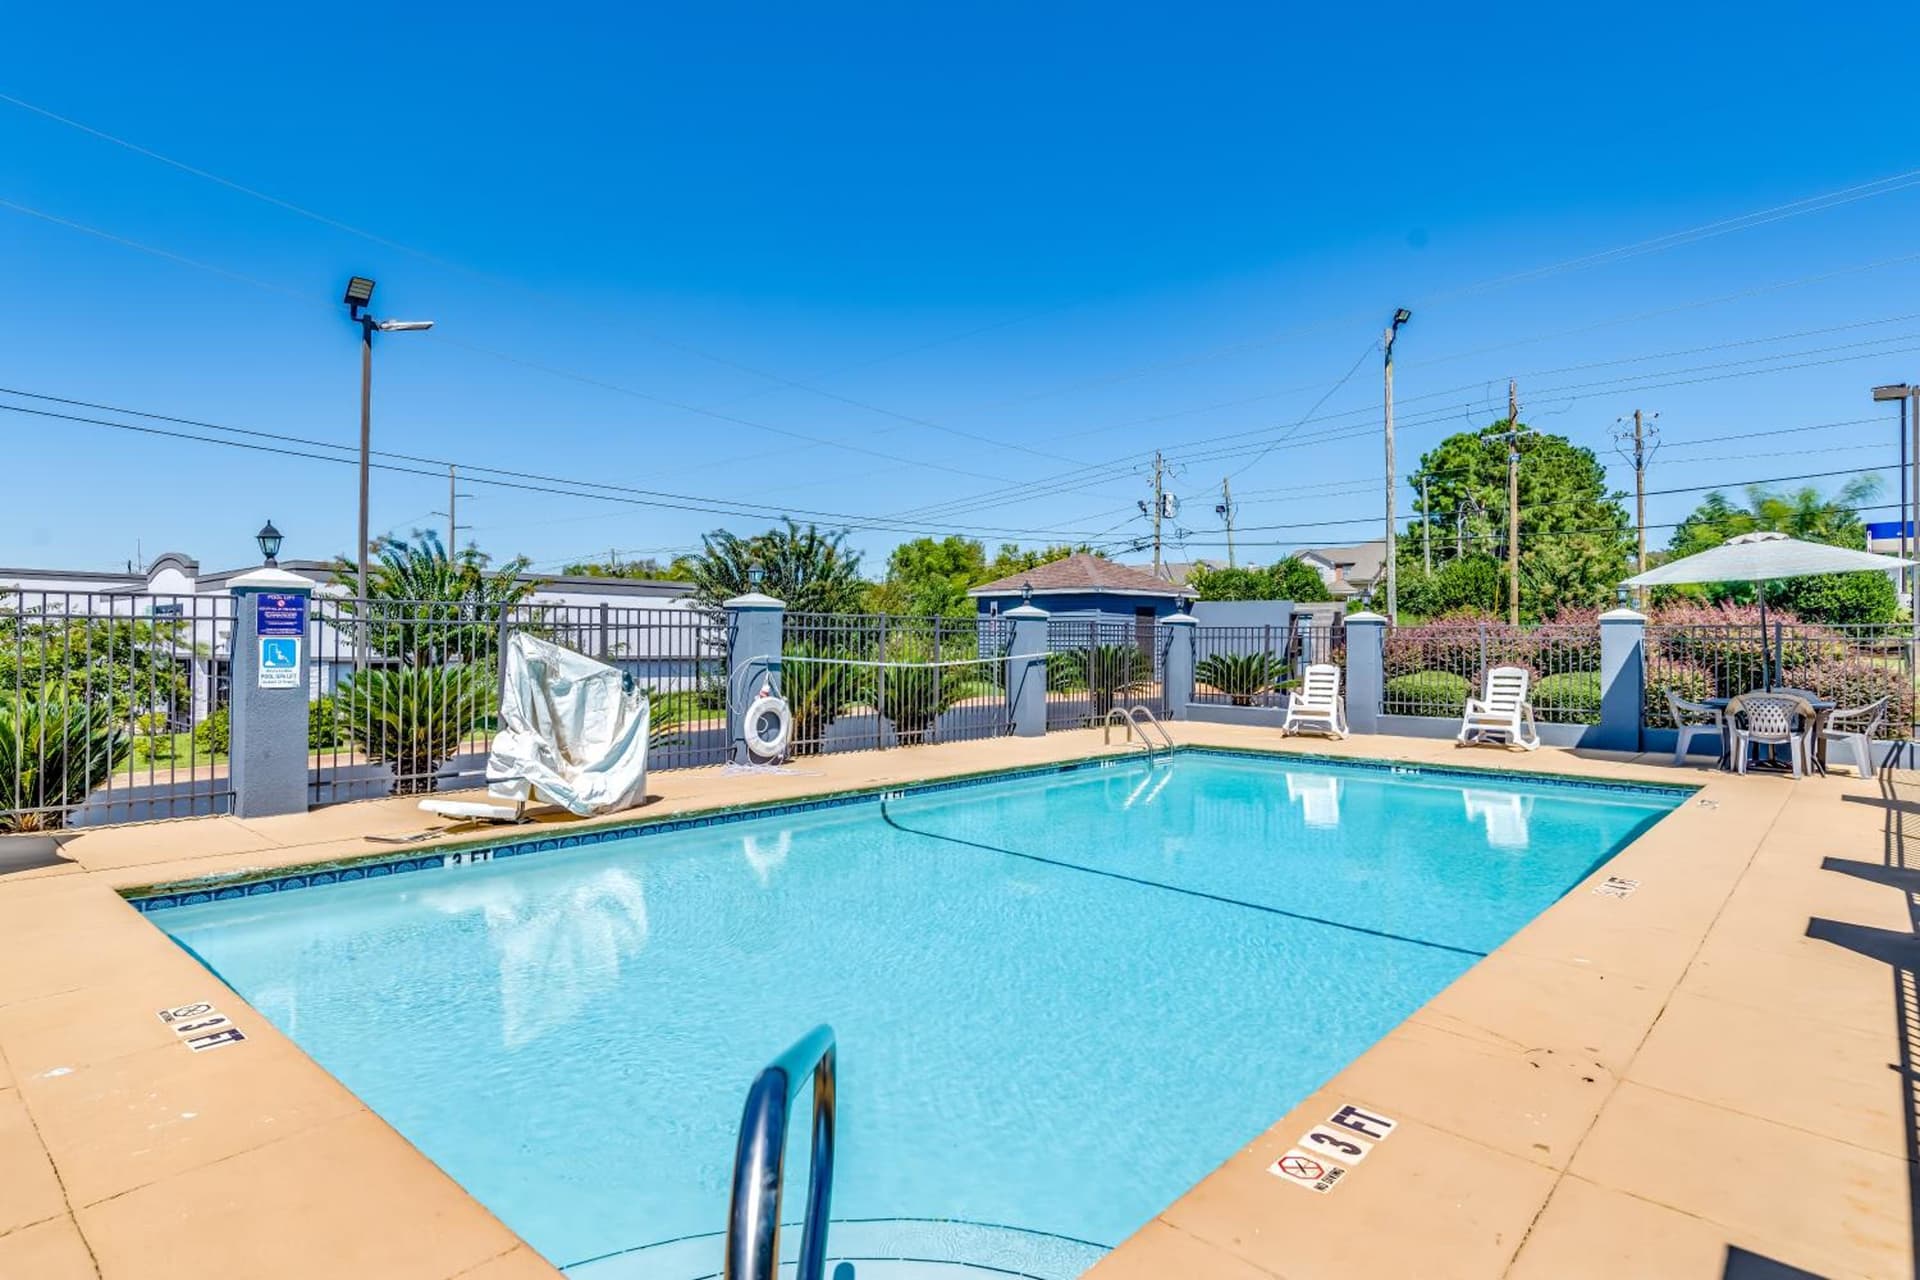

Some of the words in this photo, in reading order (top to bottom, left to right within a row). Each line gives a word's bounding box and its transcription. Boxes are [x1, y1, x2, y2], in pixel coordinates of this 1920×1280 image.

[470, 848, 491, 862] FT
[178, 1017, 226, 1032] 3
[187, 1027, 246, 1050] FT
[1330, 1105, 1392, 1139] FT
[1310, 1133, 1362, 1155] 3
